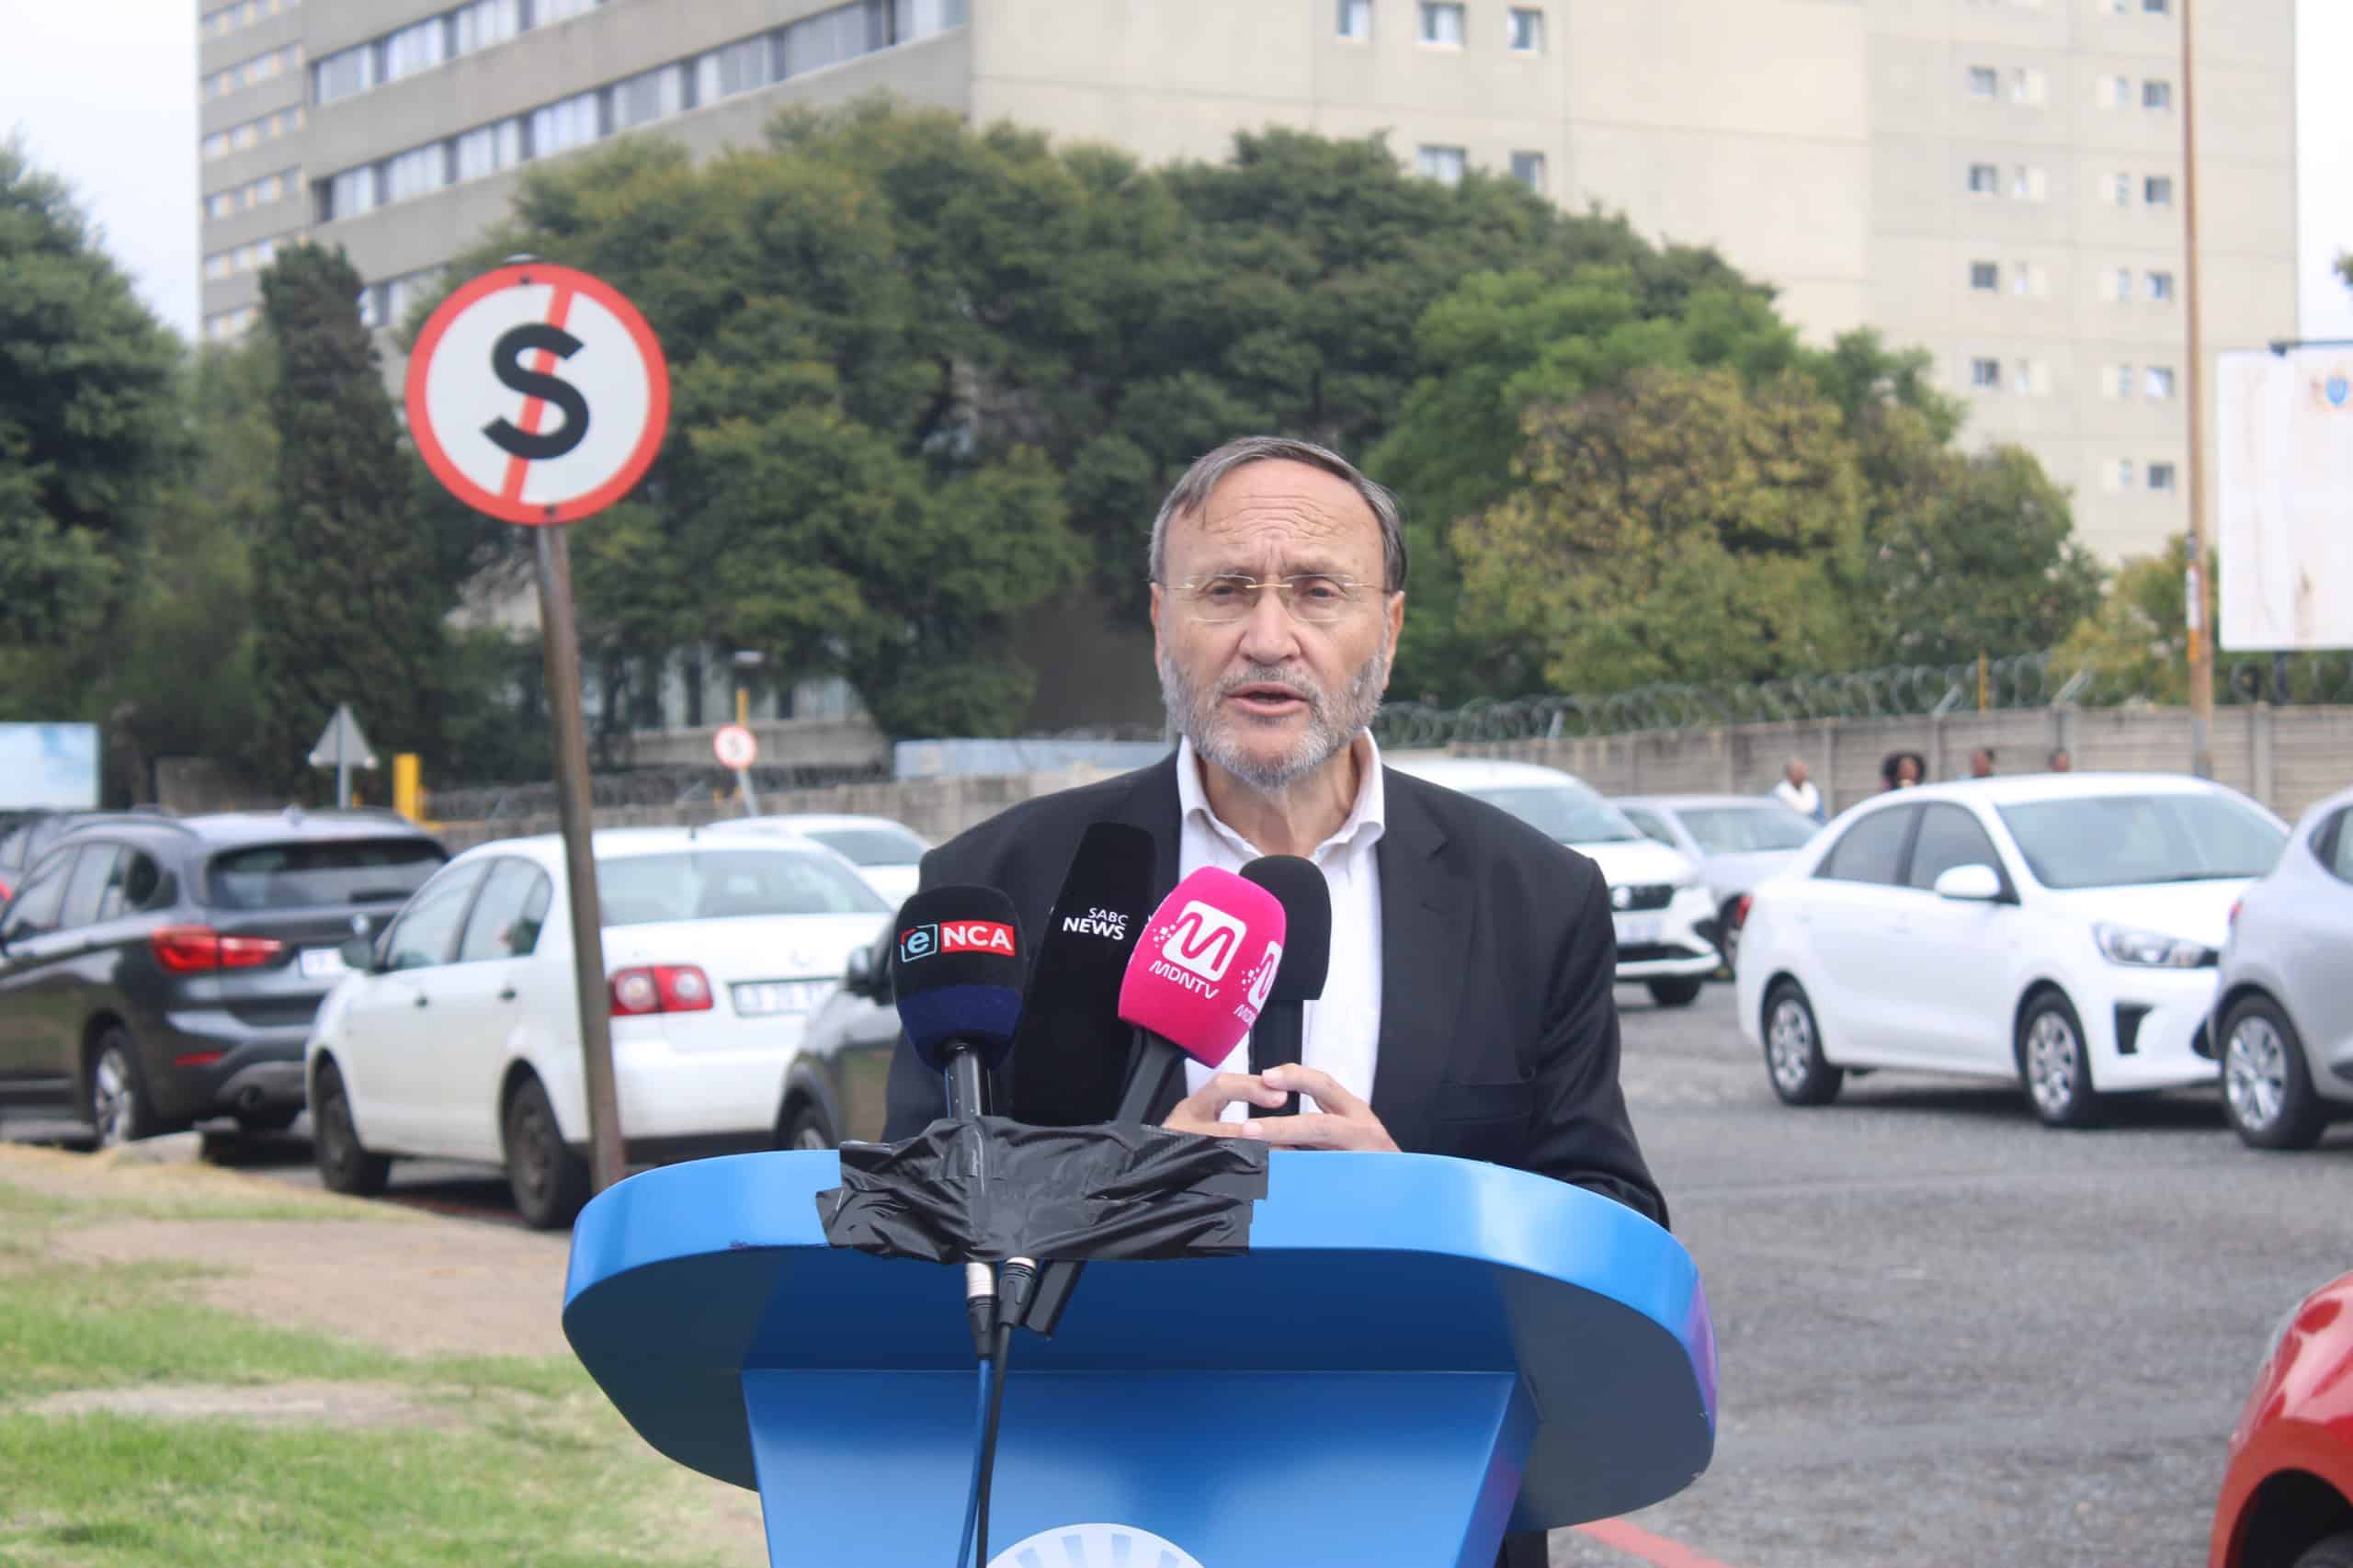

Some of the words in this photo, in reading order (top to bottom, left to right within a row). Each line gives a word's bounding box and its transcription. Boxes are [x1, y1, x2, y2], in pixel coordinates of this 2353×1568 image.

[480, 323, 590, 460] S
[1063, 917, 1126, 940] NEWS
[1088, 907, 1129, 926] SABC
[1149, 960, 1219, 999] MDNTV
